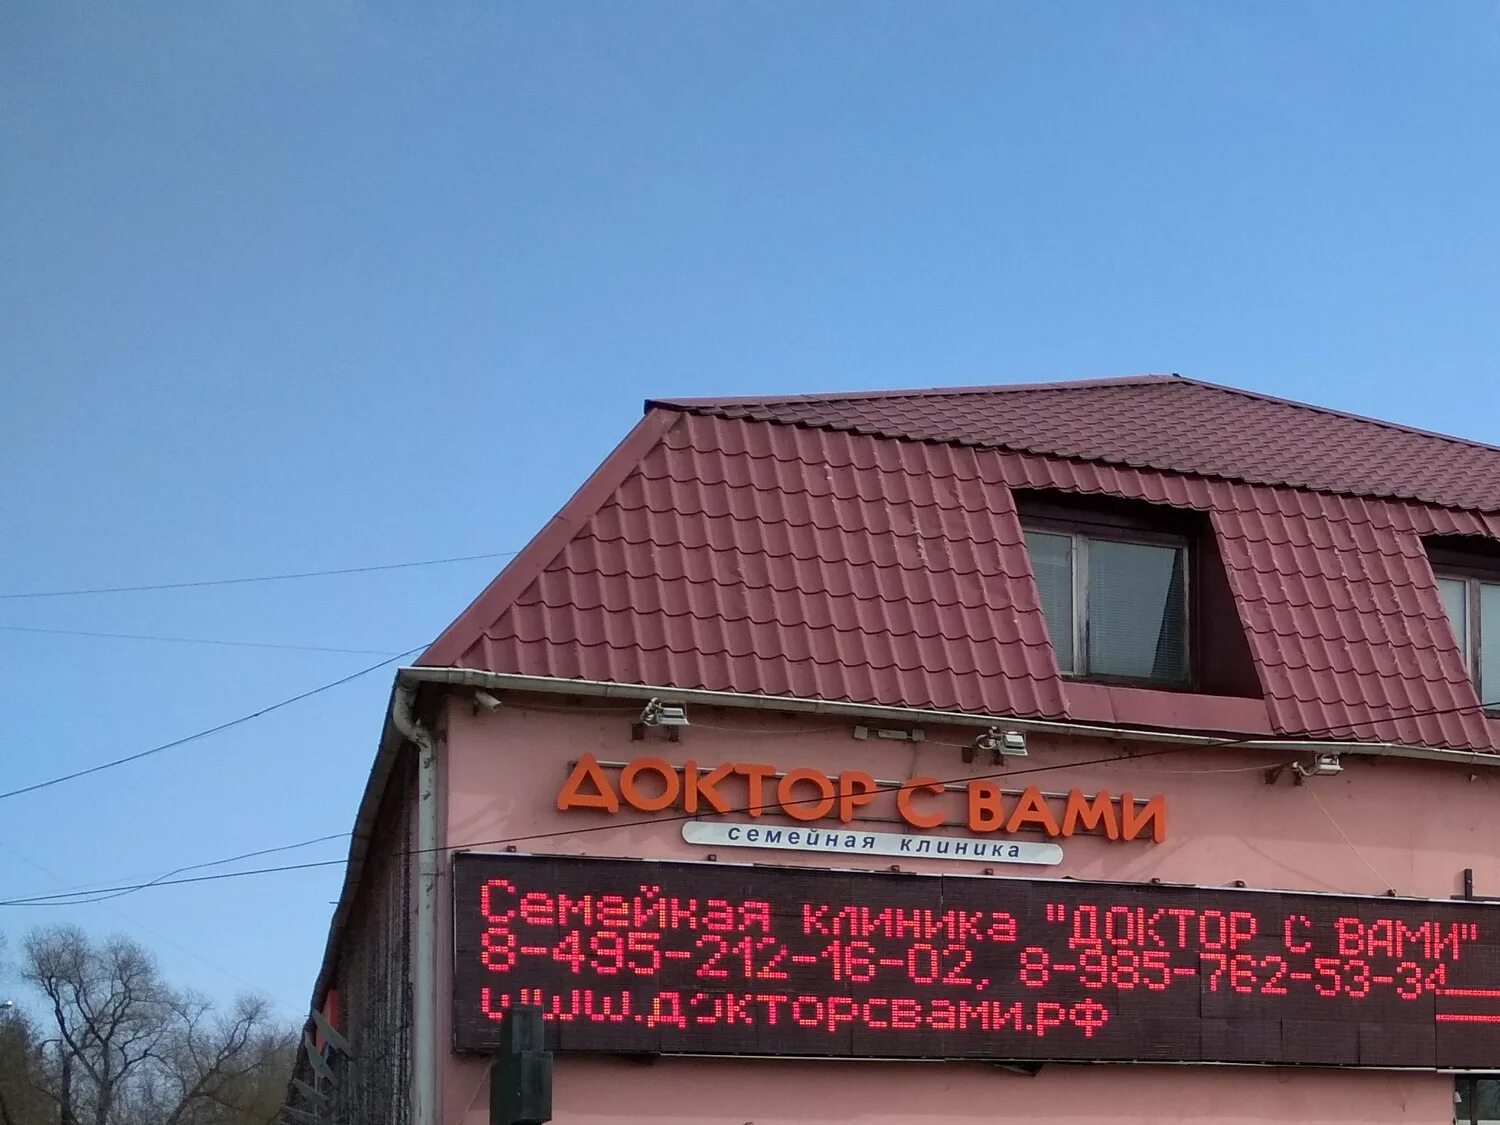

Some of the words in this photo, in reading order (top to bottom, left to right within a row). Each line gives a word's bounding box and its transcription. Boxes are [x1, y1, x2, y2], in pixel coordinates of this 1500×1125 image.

[557, 752, 876, 824] ДОКТОР
[896, 776, 946, 829] С
[967, 779, 1166, 844] ВАМИ
[727, 823, 876, 850] семейная
[899, 837, 1021, 859] клиника
[480, 879, 771, 933] Семейная
[802, 902, 1017, 942] клиника
[1046, 903, 1257, 950] "ДОКТОР
[1284, 915, 1312, 953] С
[1334, 916, 1479, 961] ВАМИ"
[1019, 945, 1448, 1000] 8-985-762-53-34
